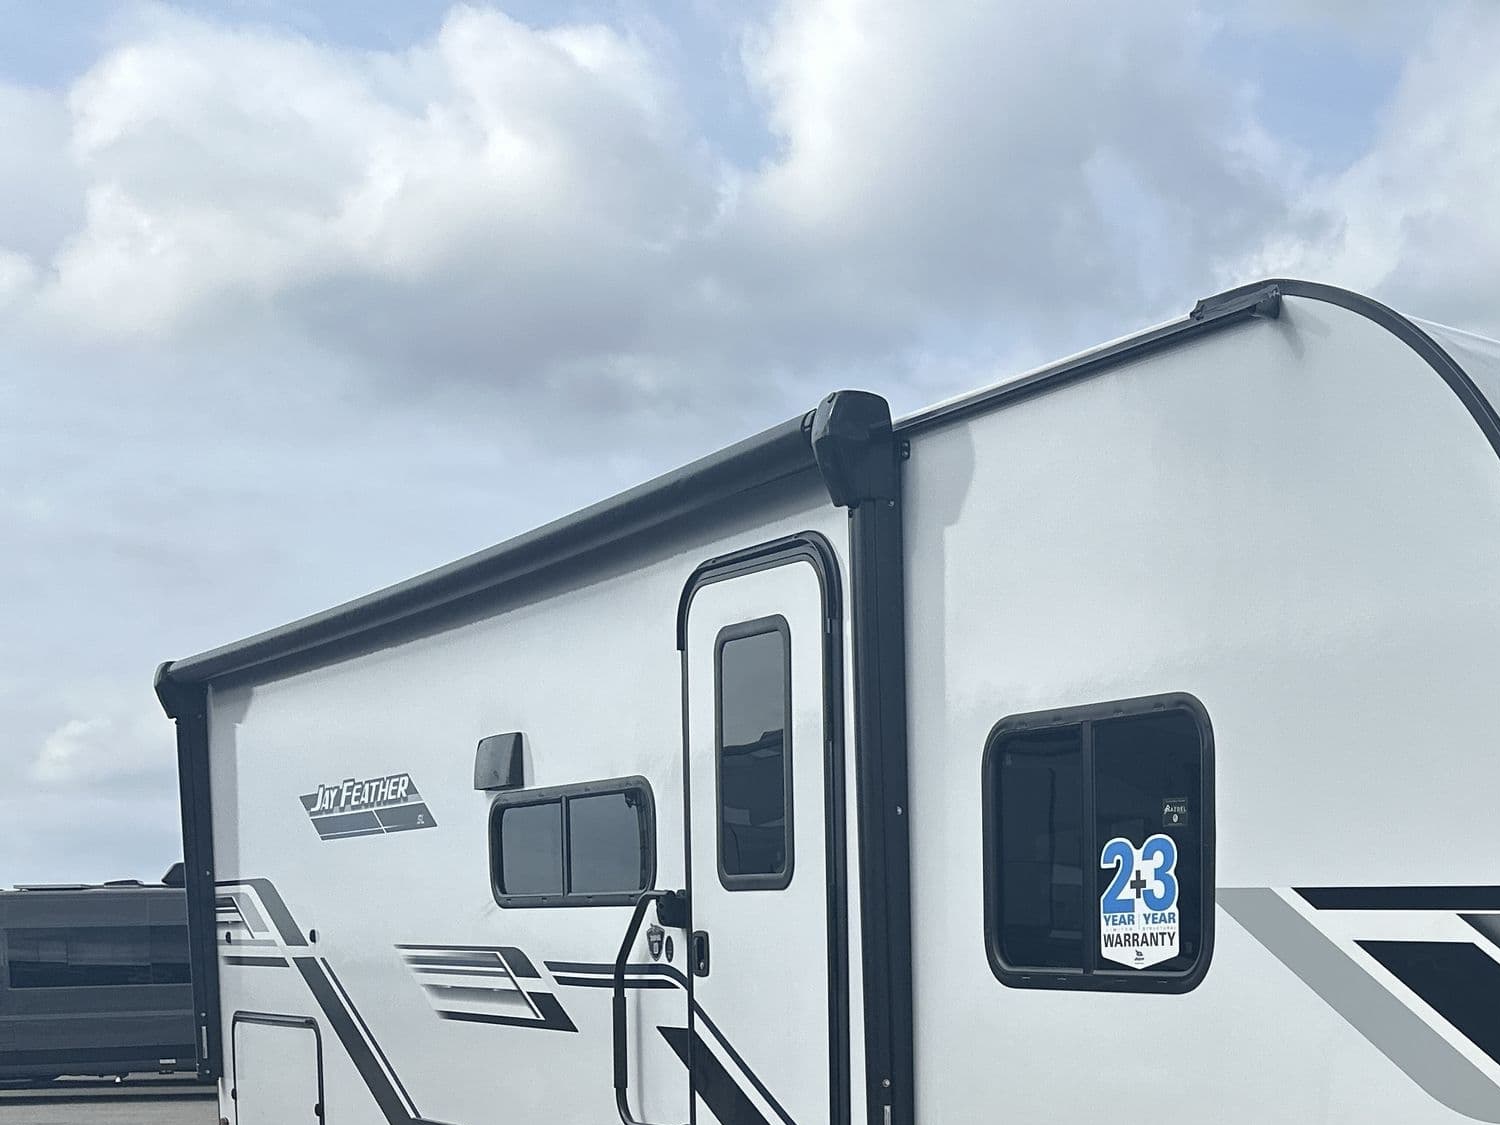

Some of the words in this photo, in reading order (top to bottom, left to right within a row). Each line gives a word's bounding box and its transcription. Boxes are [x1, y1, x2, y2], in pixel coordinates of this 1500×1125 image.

[310, 783, 339, 812] JAY
[340, 776, 409, 808] FEATHER
[1104, 914, 1135, 926] YEAR
[1143, 912, 1176, 925] YEAR
[1103, 931, 1176, 948] WARRANTY
